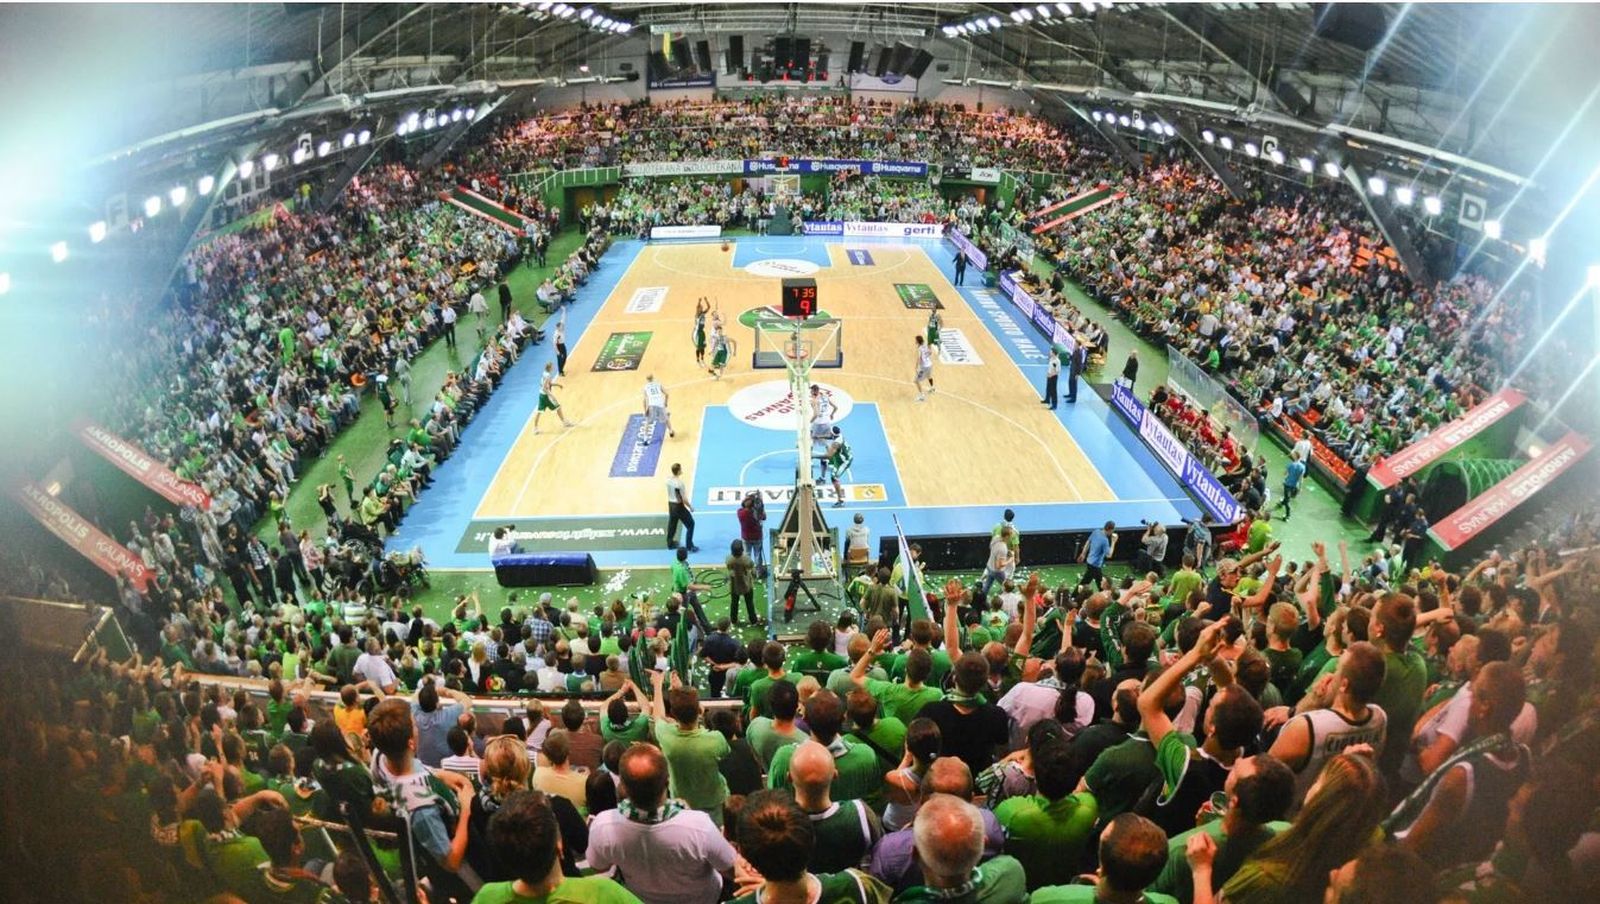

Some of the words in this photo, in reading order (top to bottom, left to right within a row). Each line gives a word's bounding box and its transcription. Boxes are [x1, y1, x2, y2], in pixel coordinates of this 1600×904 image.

[881, 163, 921, 173] Husqvarna
[846, 223, 888, 233] Vytautas
[1462, 199, 1482, 222] D
[904, 225, 935, 236] gerti
[792, 288, 798, 298] 7
[802, 287, 815, 298] 35
[800, 300, 810, 314] 9
[1111, 383, 1142, 421] ytautas
[1144, 412, 1182, 462] Vytautas
[1444, 400, 1510, 444] AKROPOLIS
[86, 425, 150, 472] AKROPOLIS
[157, 471, 205, 504] KAUNAS
[1392, 444, 1439, 475] KAUNAS
[1511, 448, 1576, 497] AKROPOLIS
[1186, 455, 1233, 519] Vytautas
[23, 484, 89, 538] AKROPOLIS
[96, 540, 144, 577] KAUNAS
[1458, 498, 1508, 533] KAUNAS
